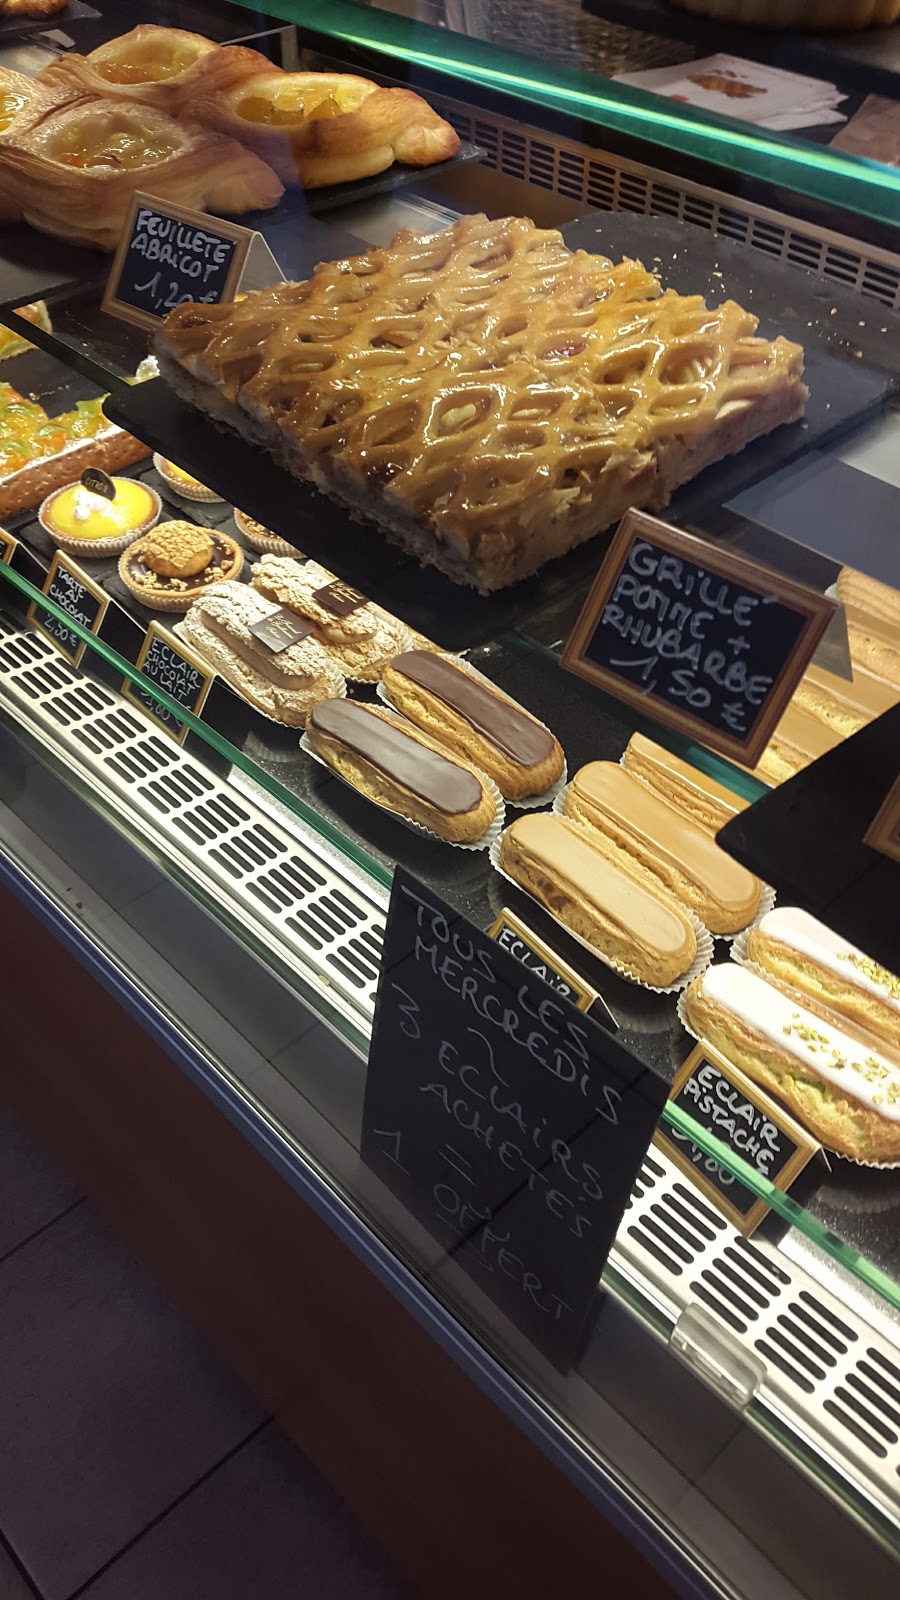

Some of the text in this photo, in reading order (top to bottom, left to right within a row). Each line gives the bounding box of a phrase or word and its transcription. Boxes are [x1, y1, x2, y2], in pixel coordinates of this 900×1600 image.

[131, 233, 219, 283] ABRICOT
[49, 584, 92, 628] CHOCOLAT
[58, 565, 87, 598] TARTE
[65, 588, 79, 604] AU
[613, 574, 750, 655] POMME +
[143, 660, 187, 701] AU LAIT
[146, 650, 196, 694] CHOCOLAT
[151, 636, 201, 688] ECLAIR
[602, 604, 773, 704] RHUBARBE
[721, 702, 746, 731] €
[401, 885, 589, 1063] TOUS LES
[415, 936, 622, 1125] MERCREDIS
[391, 982, 603, 1201] 3 ECLAIRS
[683, 1078, 775, 1169] PISTACHE
[697, 1065, 780, 1152] ECLAIR
[373, 1128, 573, 1320] 1 OFFERT
